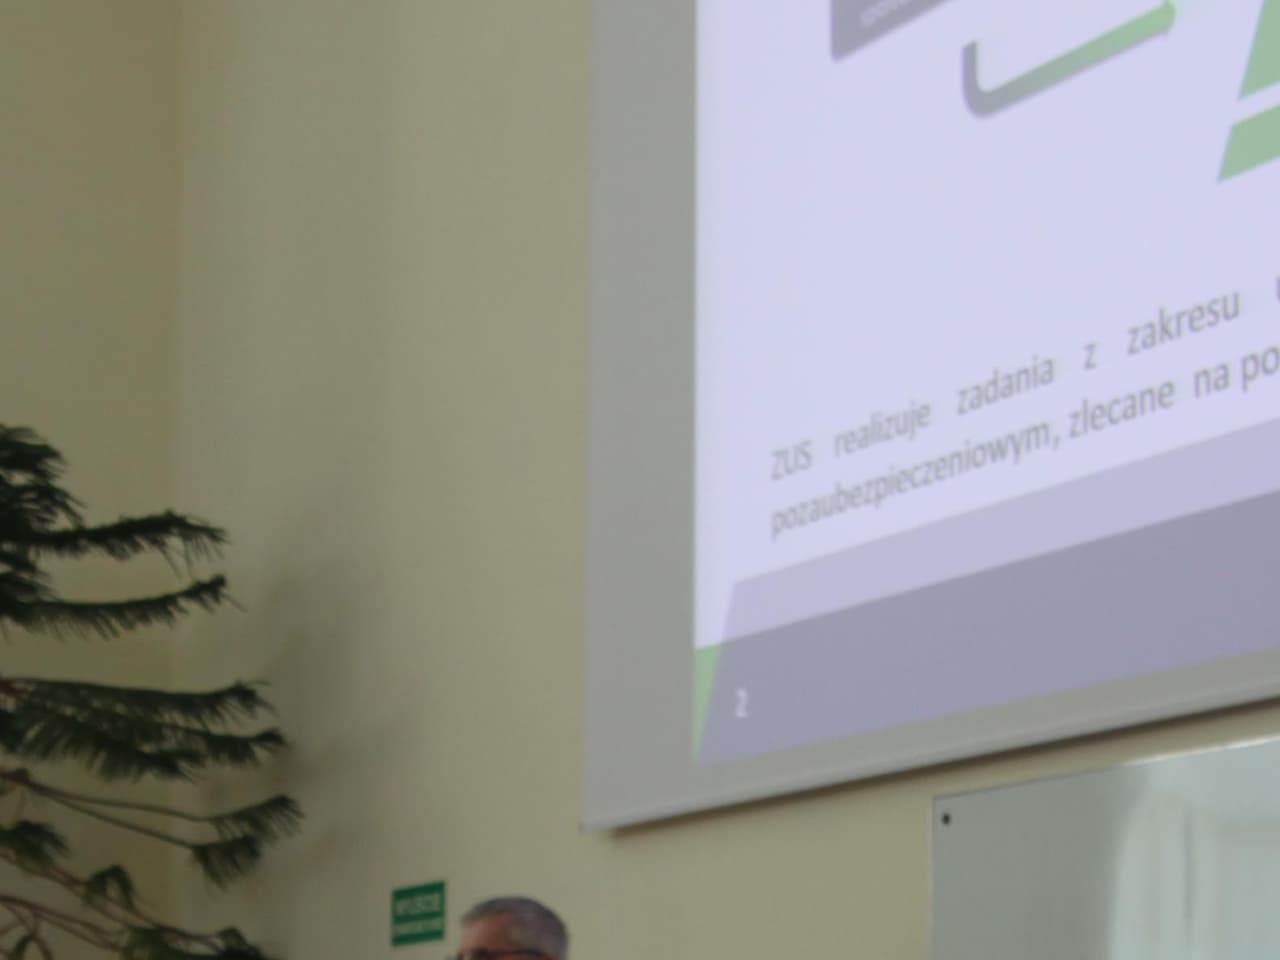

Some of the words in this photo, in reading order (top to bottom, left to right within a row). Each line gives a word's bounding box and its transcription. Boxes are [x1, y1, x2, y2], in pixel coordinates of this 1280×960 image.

[771, 440, 815, 482] ZUS
[834, 403, 933, 458] realizuje
[957, 358, 1056, 417] zadania
[1083, 343, 1099, 372] z
[1128, 291, 1241, 357] zakresu
[771, 421, 1063, 541] pozaubezpieczeniowym,
[1068, 380, 1177, 440] zlecane
[1193, 363, 1232, 401] na
[734, 688, 749, 718] 2
